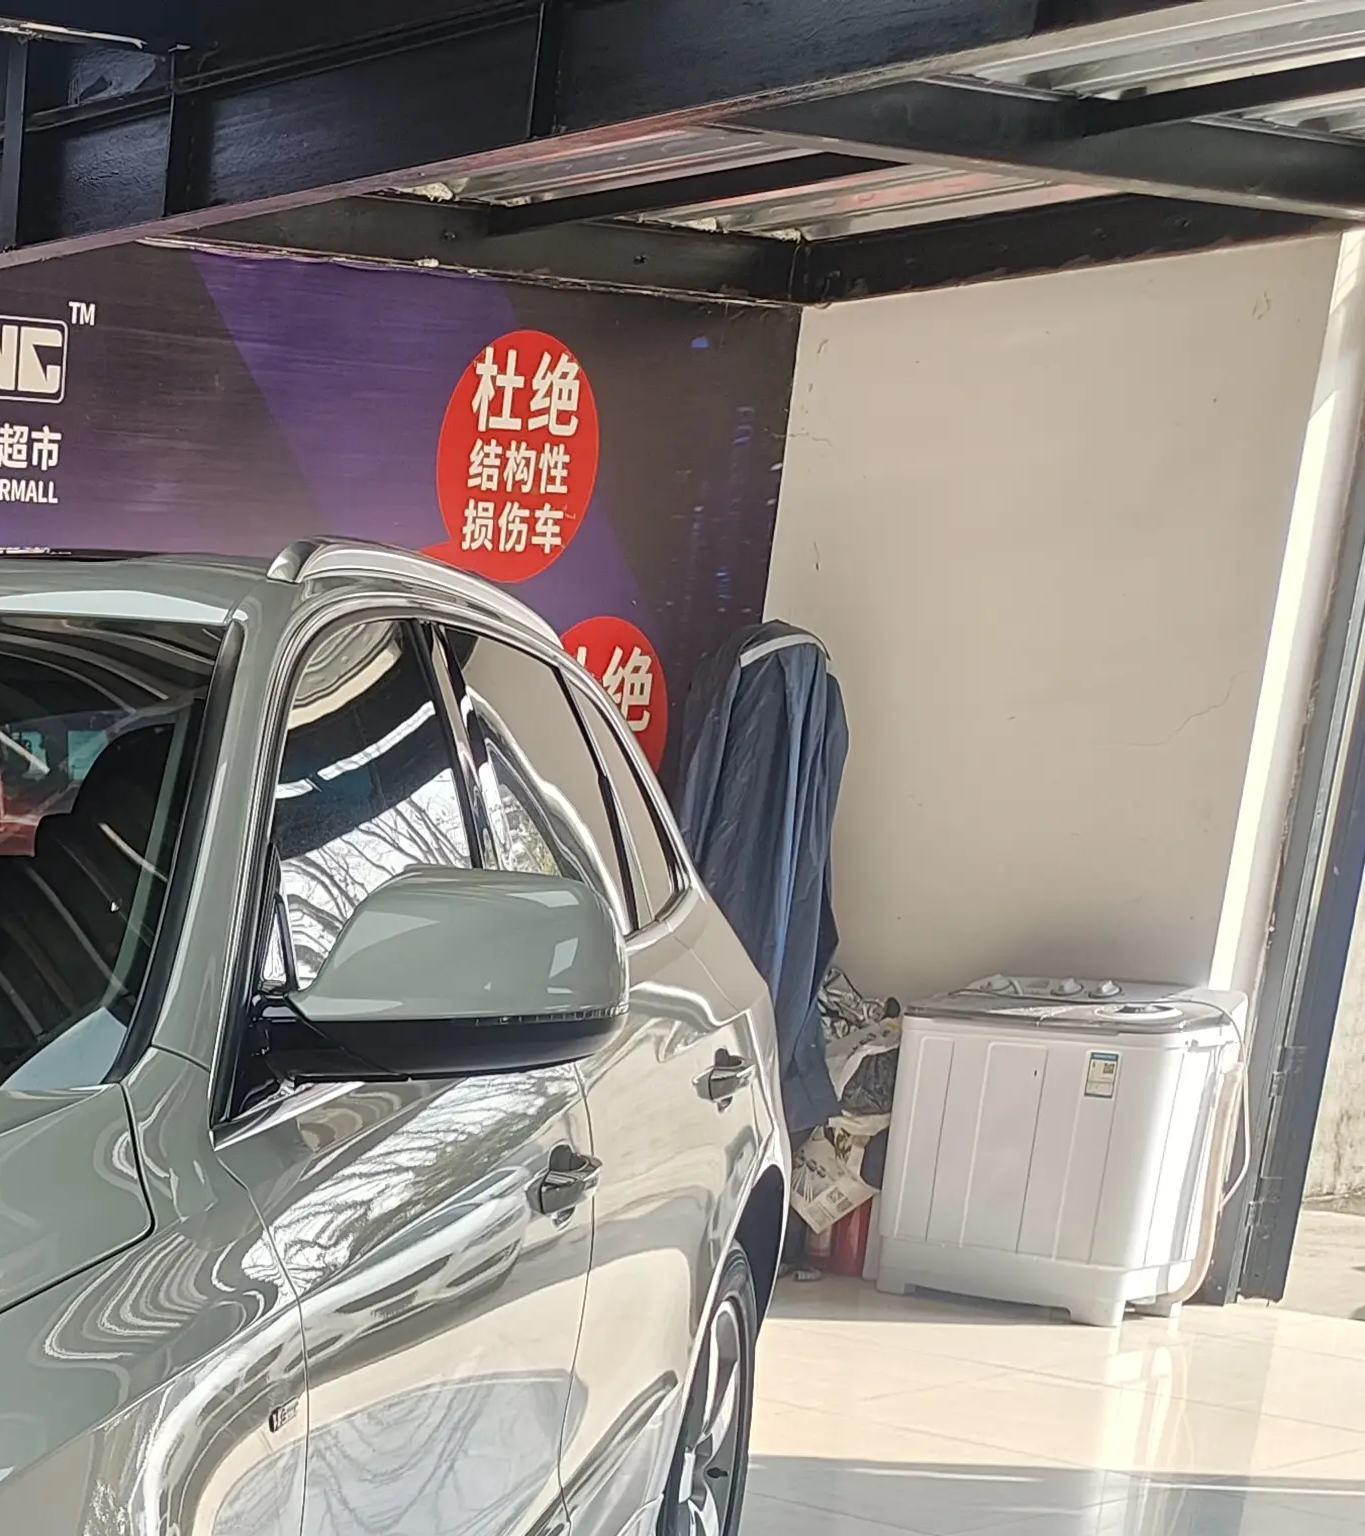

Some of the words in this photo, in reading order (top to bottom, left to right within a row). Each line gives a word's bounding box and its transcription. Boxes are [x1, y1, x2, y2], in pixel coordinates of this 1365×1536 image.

[69, 302, 95, 326] TM
[471, 347, 581, 436] 杜绝
[467, 439, 570, 495] 结构性
[461, 499, 566, 554] 损伤车
